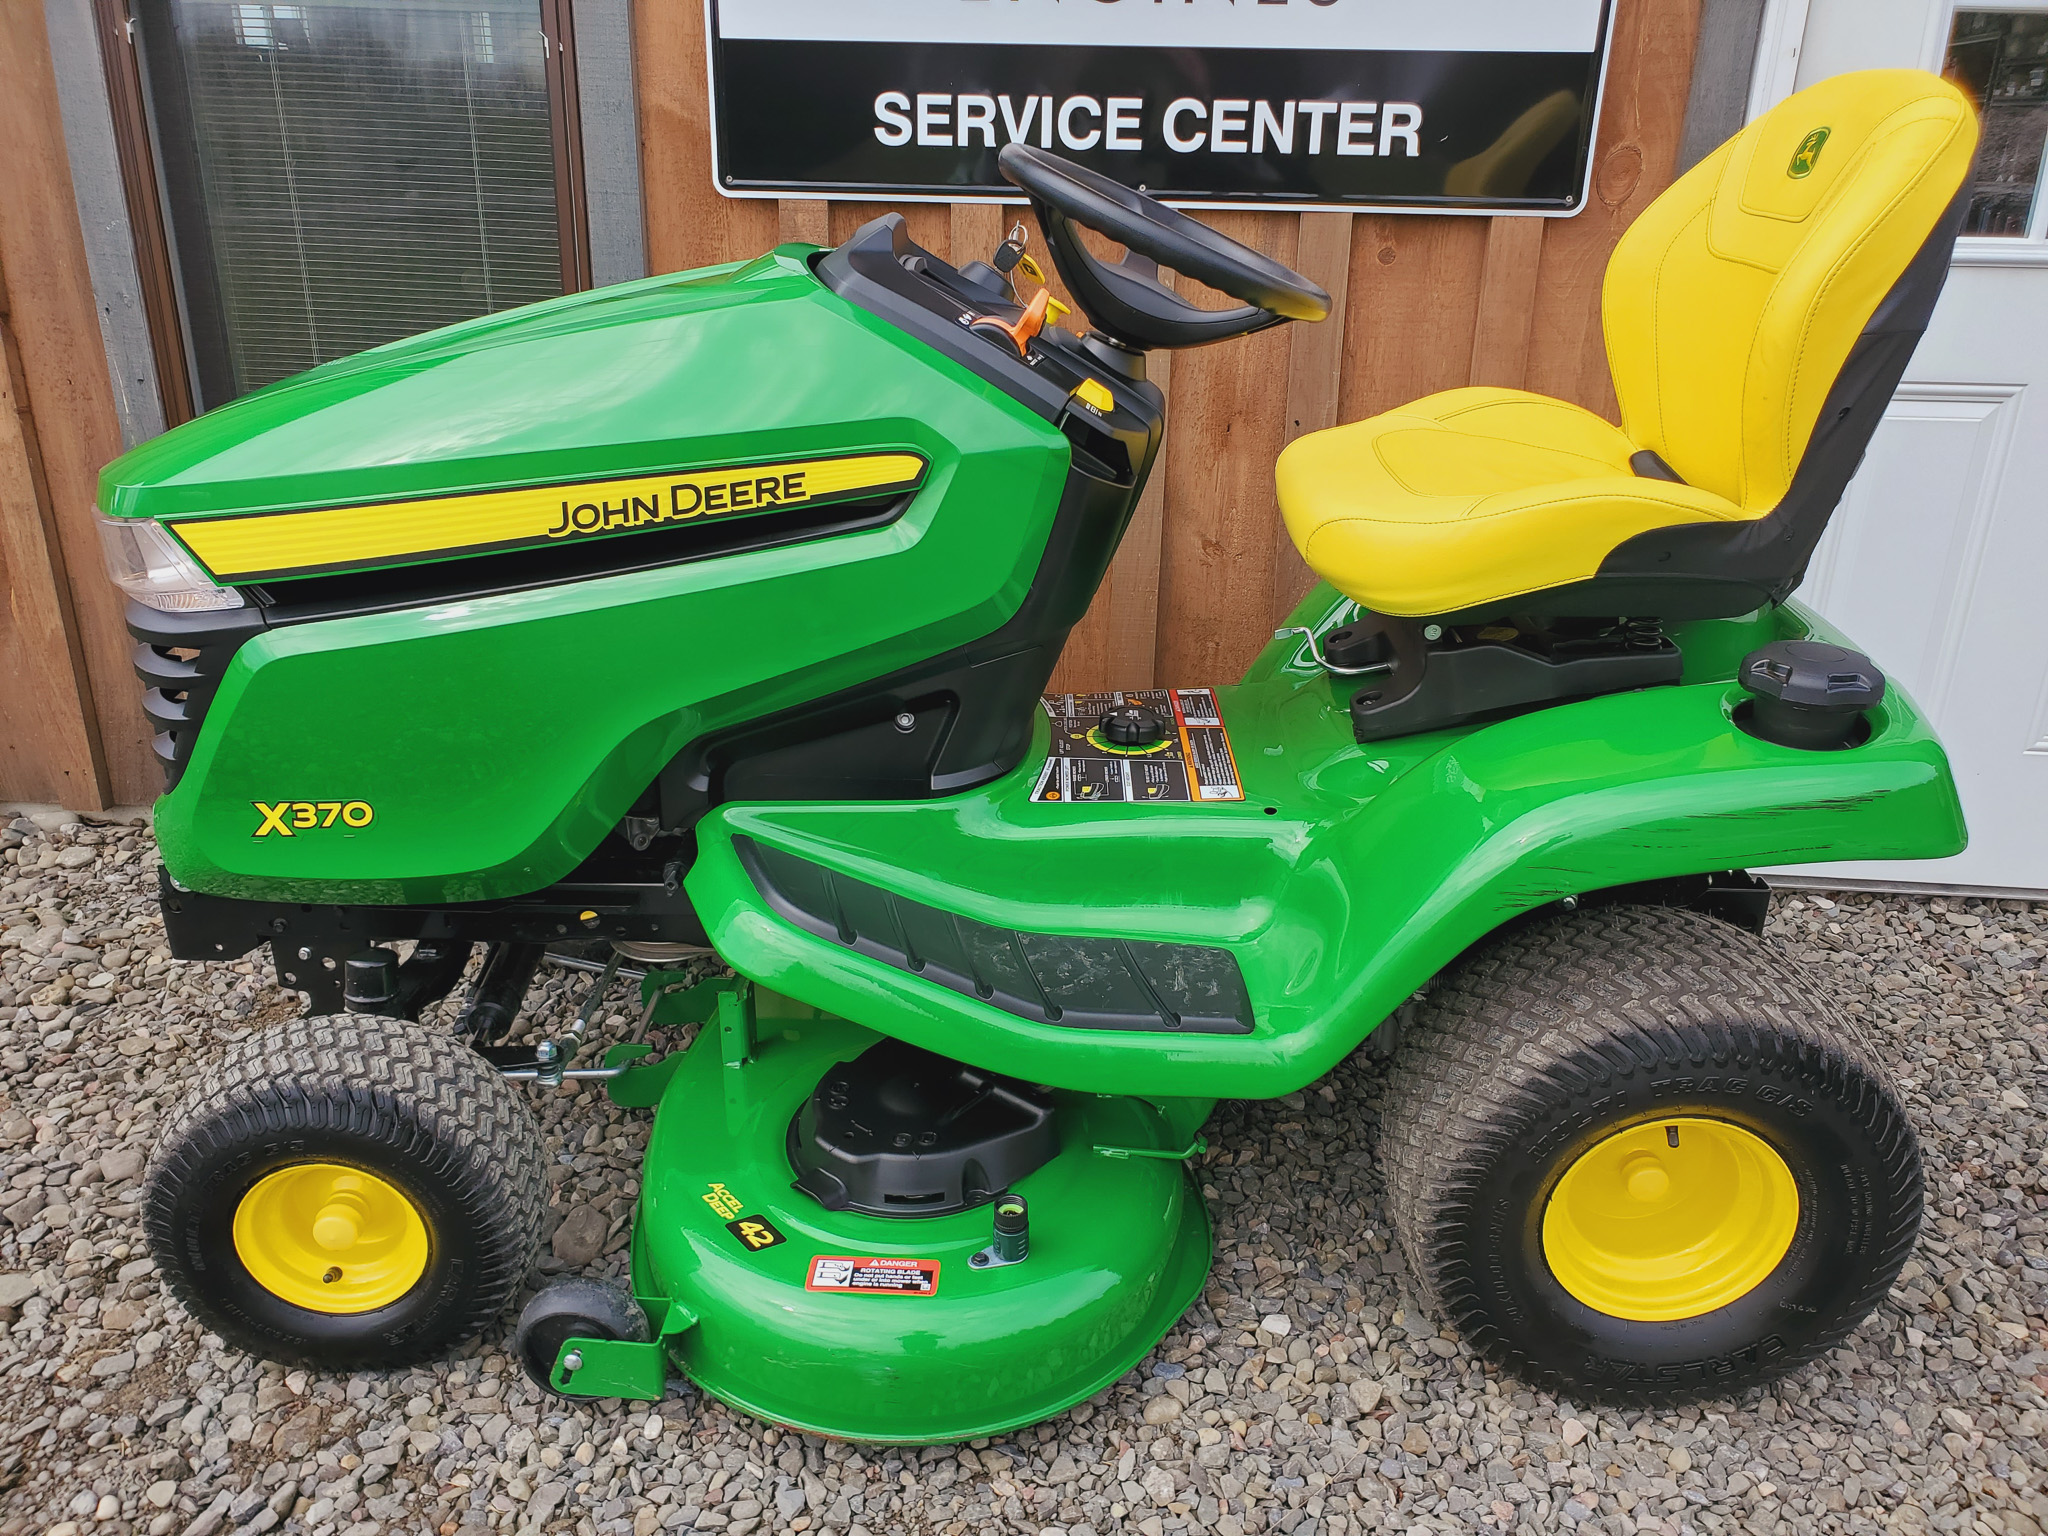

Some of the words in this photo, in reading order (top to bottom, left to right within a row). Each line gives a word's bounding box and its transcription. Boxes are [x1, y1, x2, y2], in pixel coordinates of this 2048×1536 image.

[873, 91, 1143, 153] SERVICE
[1162, 97, 1424, 158] CENTER
[548, 493, 660, 536] JOHN
[670, 471, 808, 518] DEERE
[250, 799, 375, 838] X370
[701, 1193, 736, 1221] DEEP
[707, 1182, 746, 1214] ACCEL
[737, 1219, 776, 1249] 42
[879, 1259, 918, 1268] DANGER
[1582, 1333, 1788, 1384] CARLSTAR
